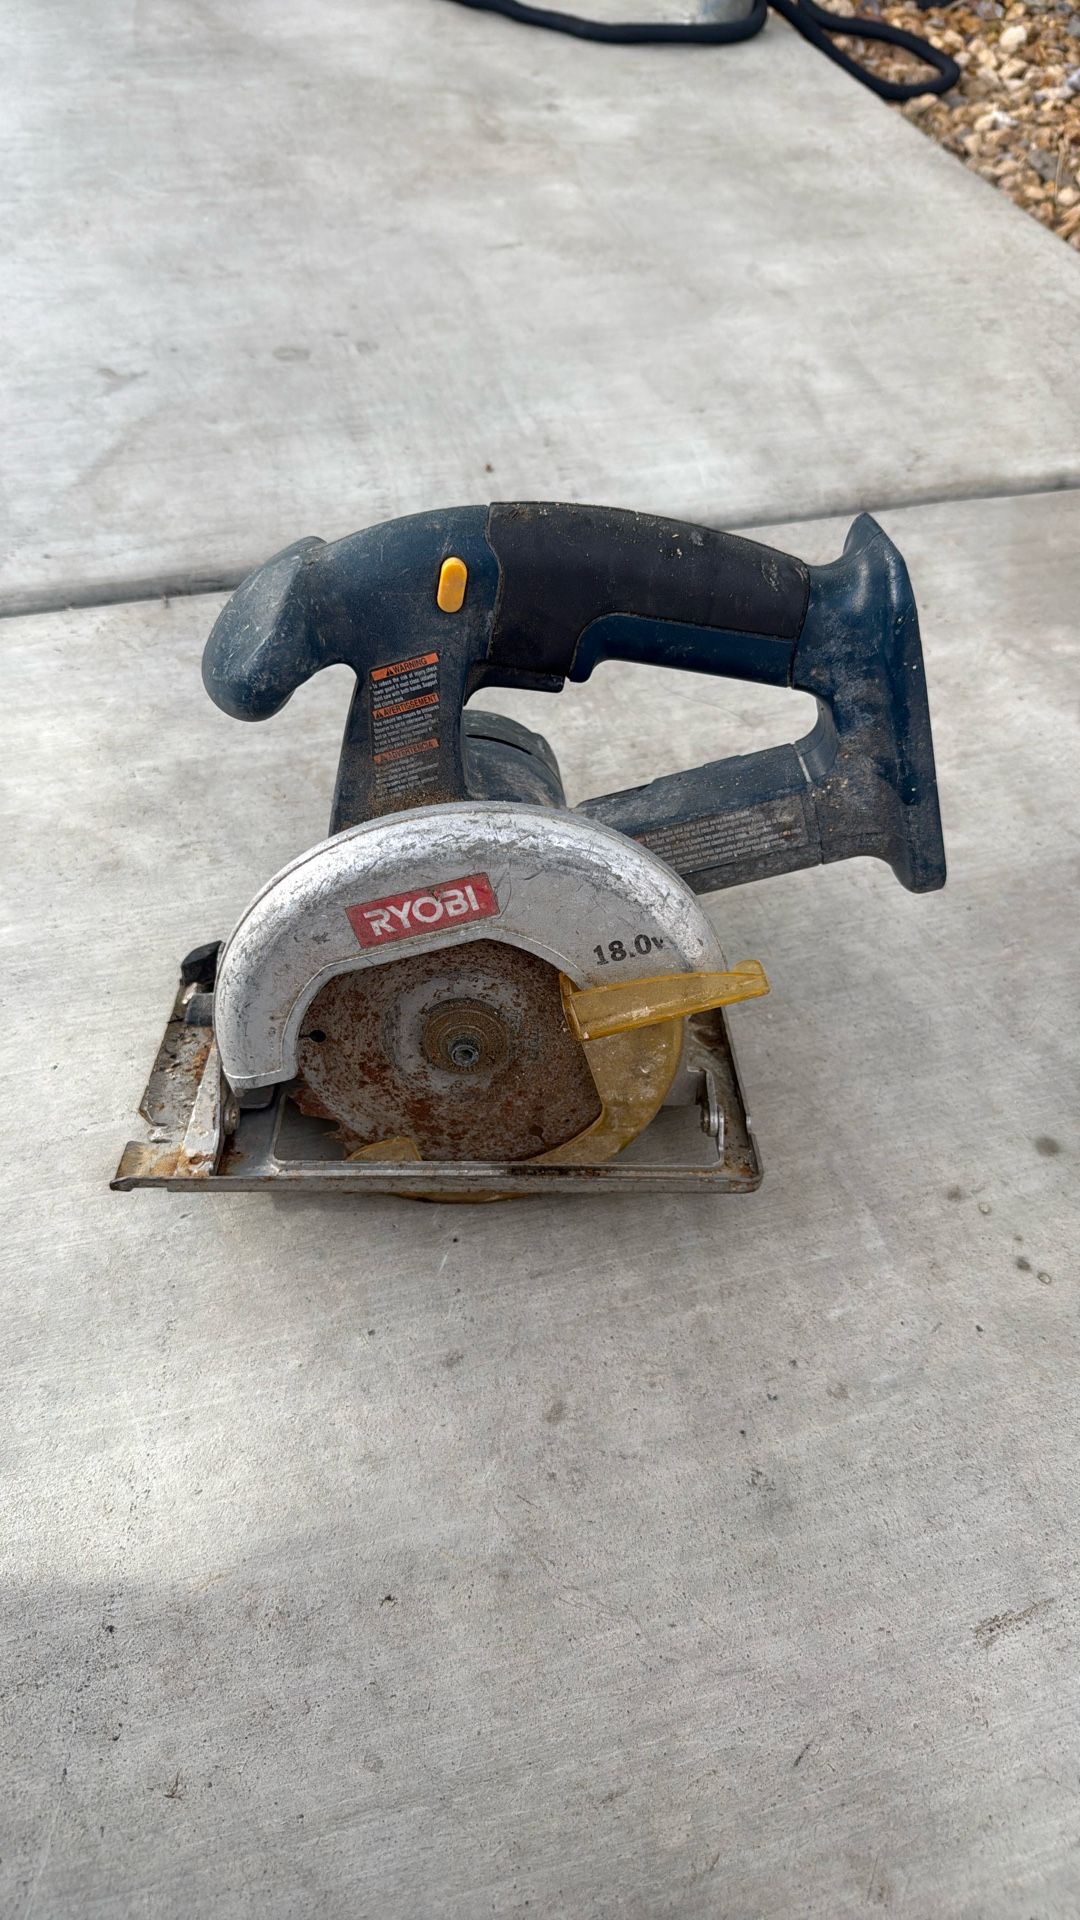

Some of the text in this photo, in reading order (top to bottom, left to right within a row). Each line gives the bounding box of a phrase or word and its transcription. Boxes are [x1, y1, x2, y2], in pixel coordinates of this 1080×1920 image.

[393, 658, 427, 674] WARNING
[384, 695, 436, 715] AVERTISSEMENT
[388, 742, 433, 759] ADVERTENCIA
[363, 885, 479, 937] RYOBI
